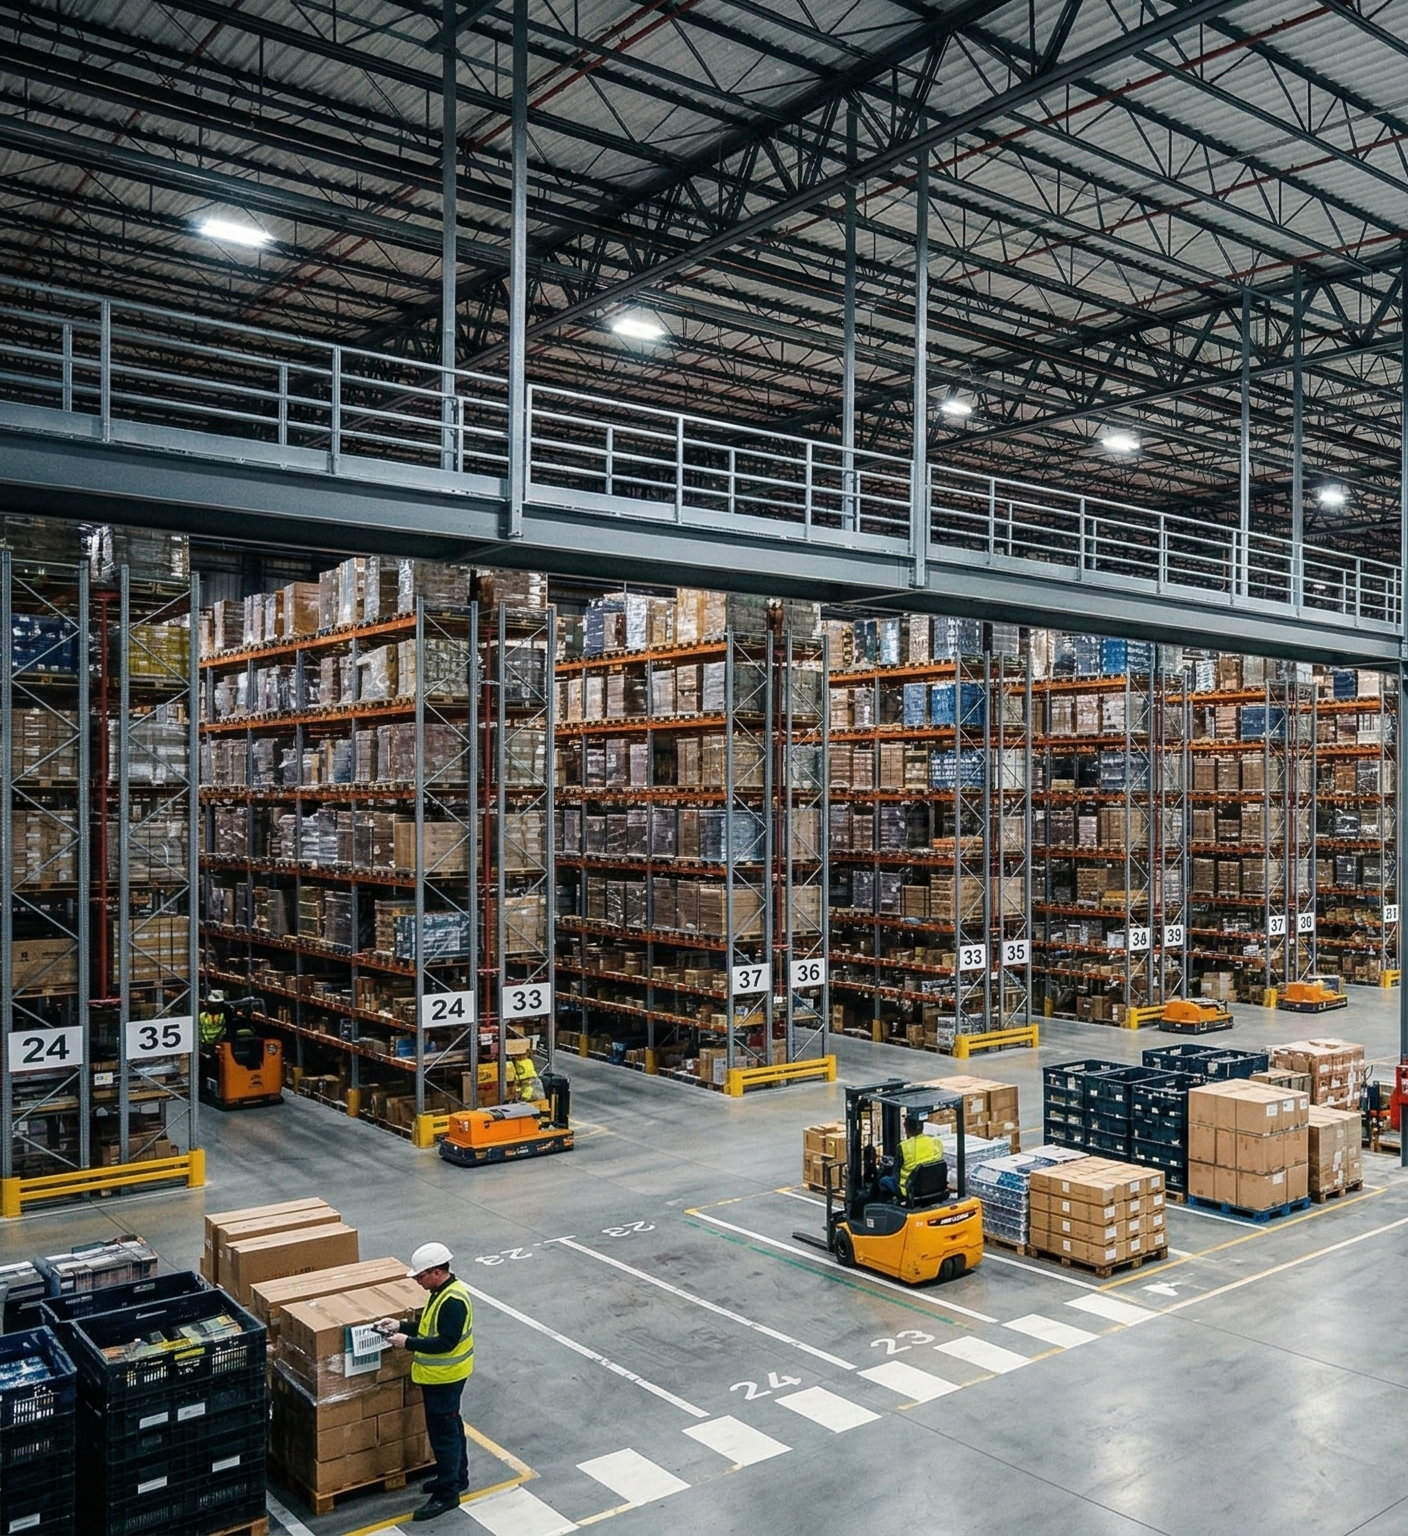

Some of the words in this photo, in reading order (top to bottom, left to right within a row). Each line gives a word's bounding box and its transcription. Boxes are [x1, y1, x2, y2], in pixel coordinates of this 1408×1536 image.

[1168, 929, 1181, 942] 39
[1271, 919, 1283, 932] 37
[964, 950, 981, 965] 33
[1008, 944, 1024, 960] 35
[740, 969, 762, 988] 37
[798, 964, 819, 981] 36
[432, 998, 465, 1020] 24
[513, 990, 542, 1011] 33
[139, 1024, 181, 1050] 35
[23, 1034, 69, 1063] 24
[871, 1330, 935, 1354] 23
[730, 1372, 801, 1400] 24
